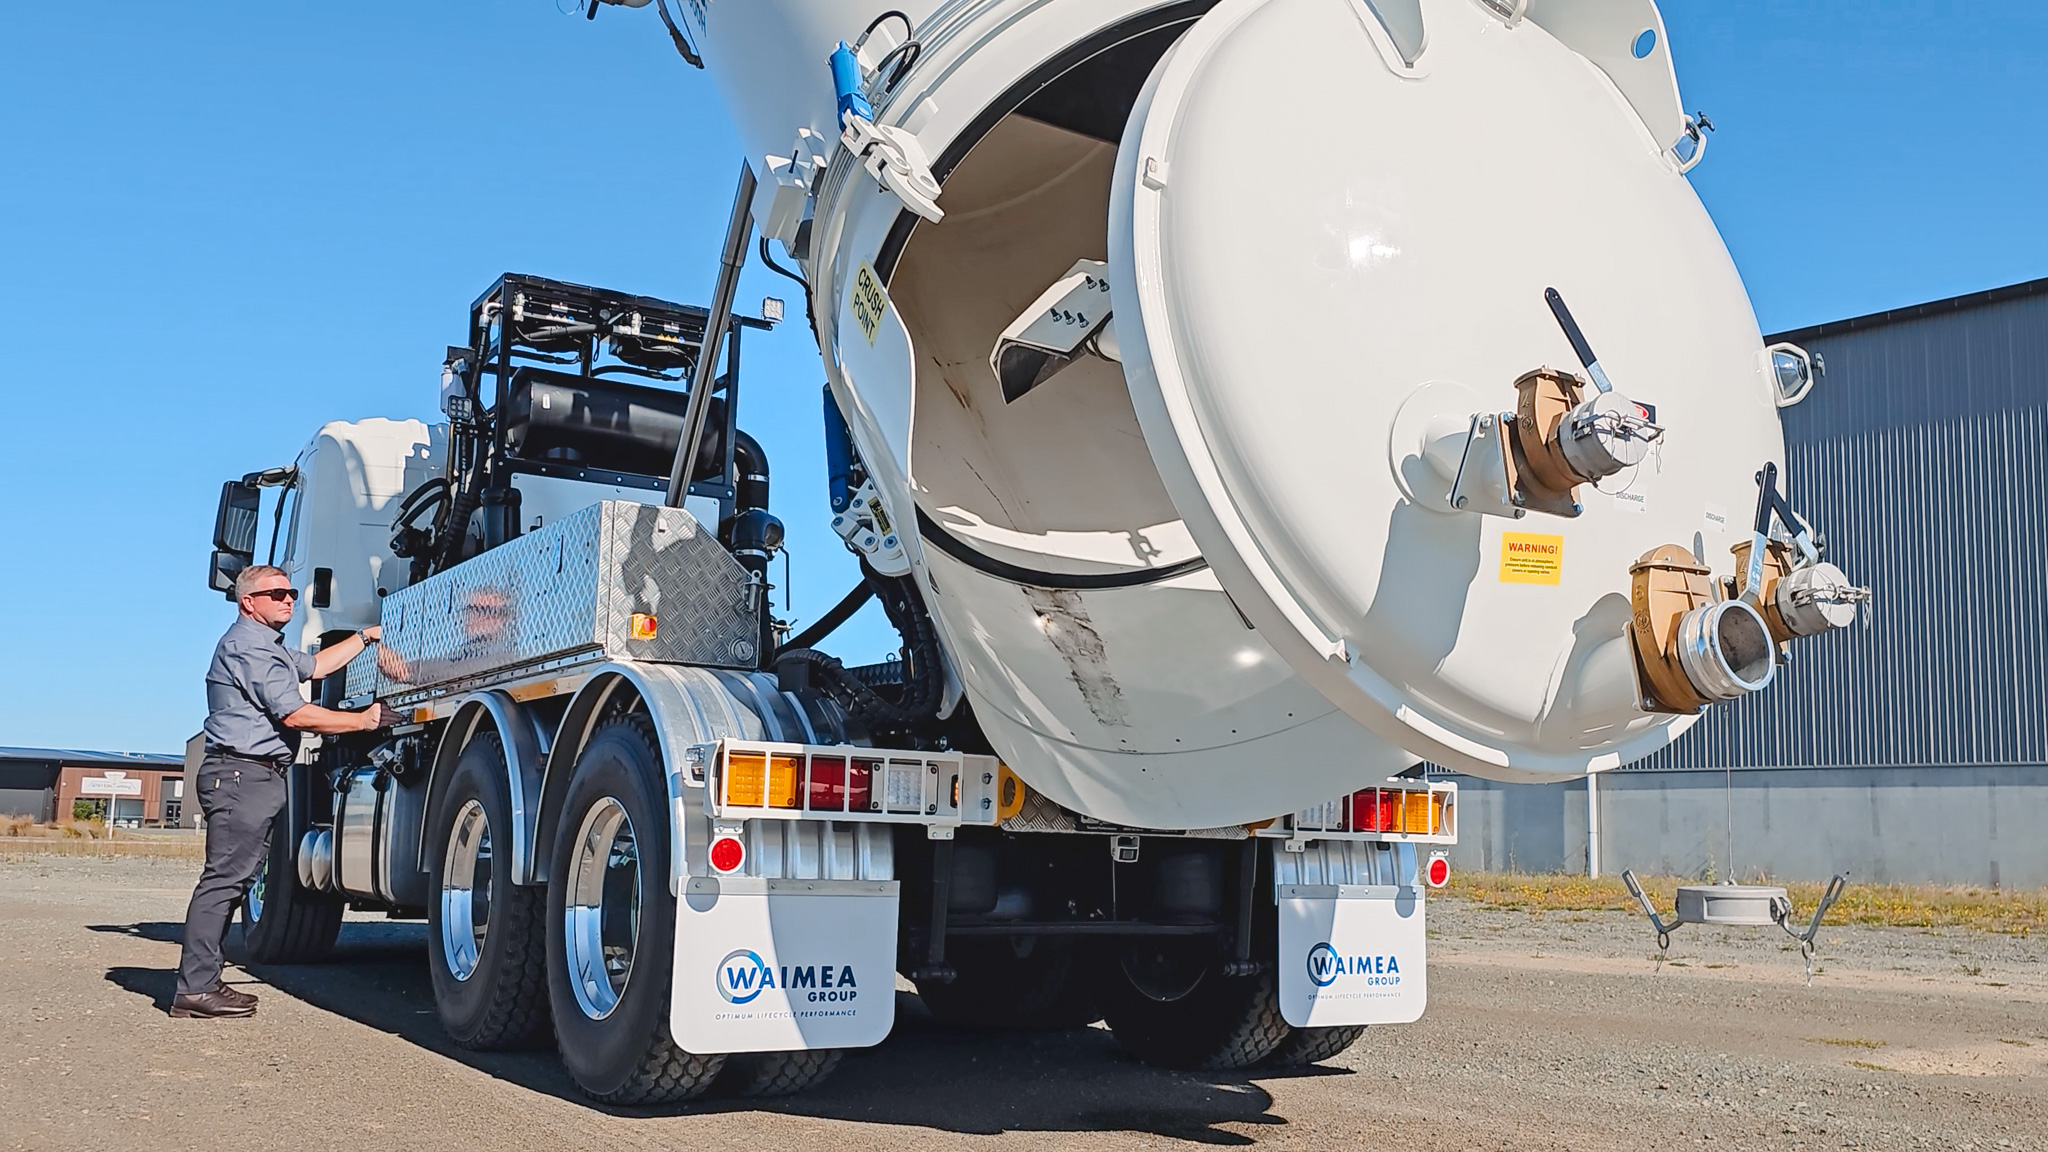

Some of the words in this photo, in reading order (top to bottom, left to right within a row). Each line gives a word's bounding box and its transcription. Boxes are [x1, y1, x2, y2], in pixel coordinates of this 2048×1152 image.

[857, 267, 885, 321] CRUSH
[852, 292, 876, 339] POINT
[1615, 491, 1645, 503] DISCHARGE
[1705, 511, 1725, 524] DISCHARGE
[1509, 542, 1558, 554] WARNING!
[1313, 956, 1400, 976] WAIMEA
[726, 965, 857, 990] WAIMEA
[1367, 976, 1401, 986] GROUP
[807, 990, 858, 1003] GROUP
[715, 1013, 754, 1021] OPTIMUM
[756, 1012, 797, 1020] LIFECYCLE
[800, 1009, 857, 1018] PERFORMANCE
